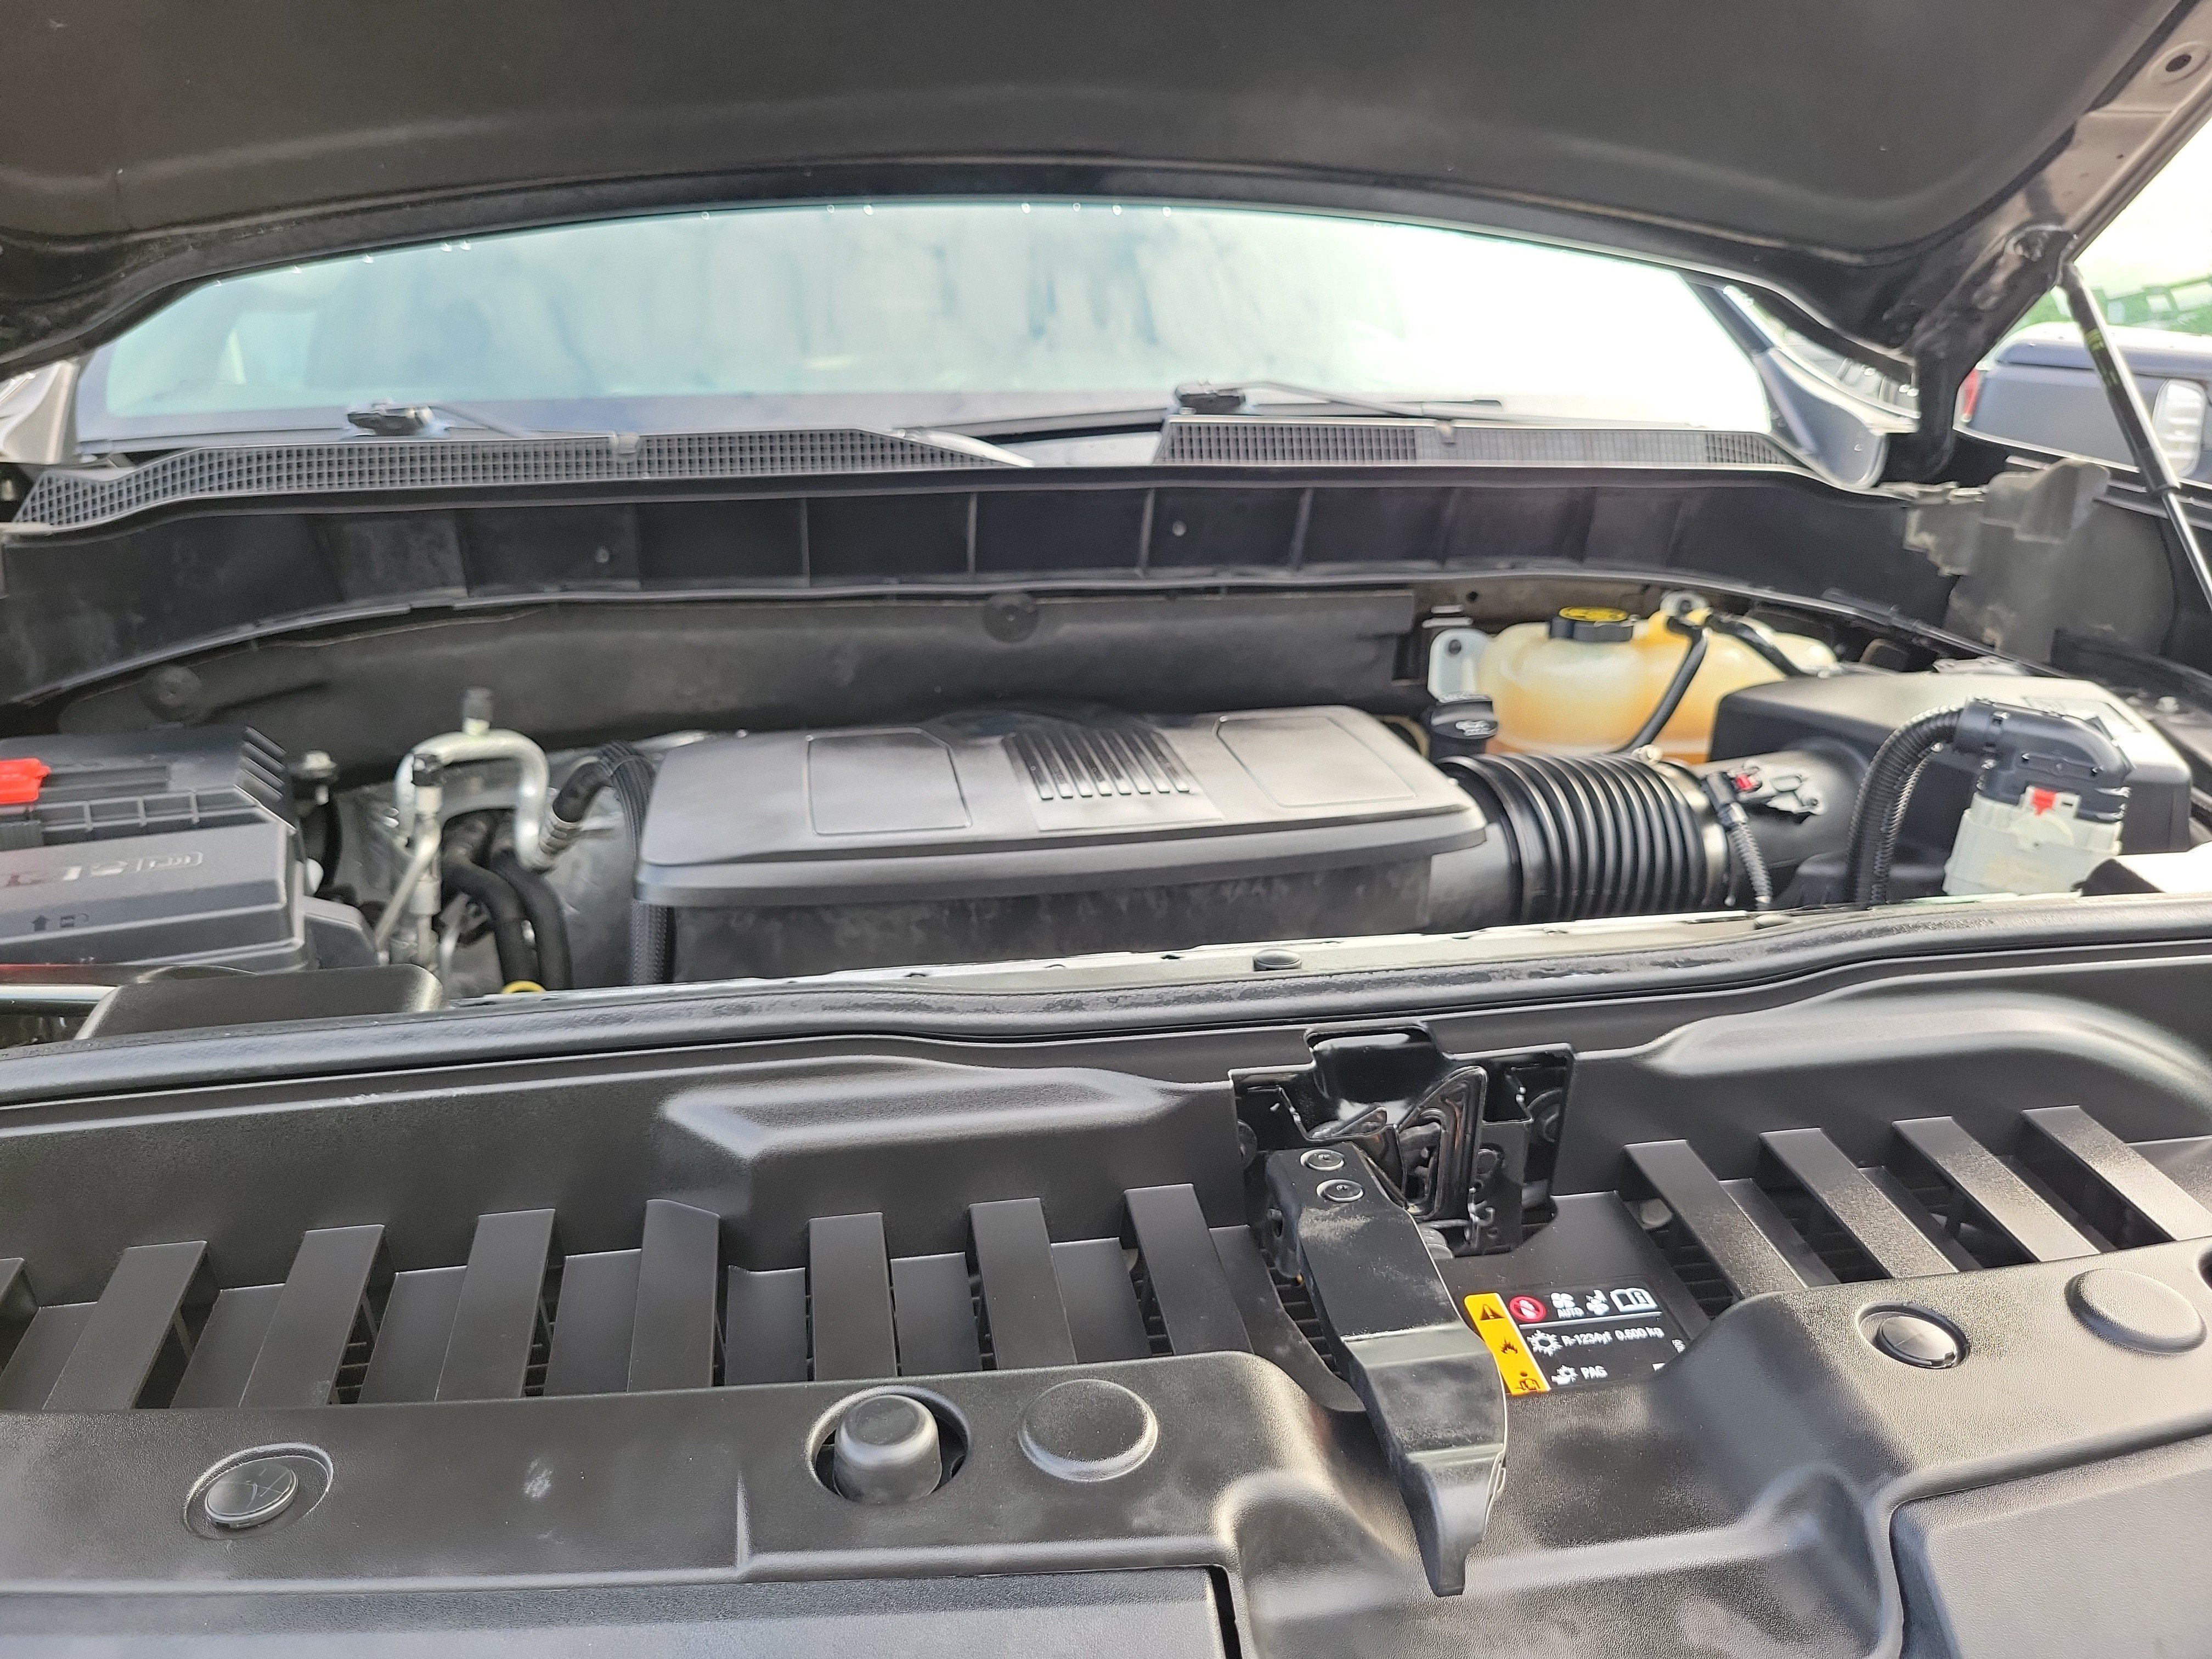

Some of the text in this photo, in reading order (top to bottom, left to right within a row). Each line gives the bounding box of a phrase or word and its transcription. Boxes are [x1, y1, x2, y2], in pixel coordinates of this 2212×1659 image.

[1558, 1307, 1584, 1318] AUTO
[1561, 1327, 1664, 1347] R-1234yf 0.600 kg
[1580, 1365, 1608, 1379] PAG
